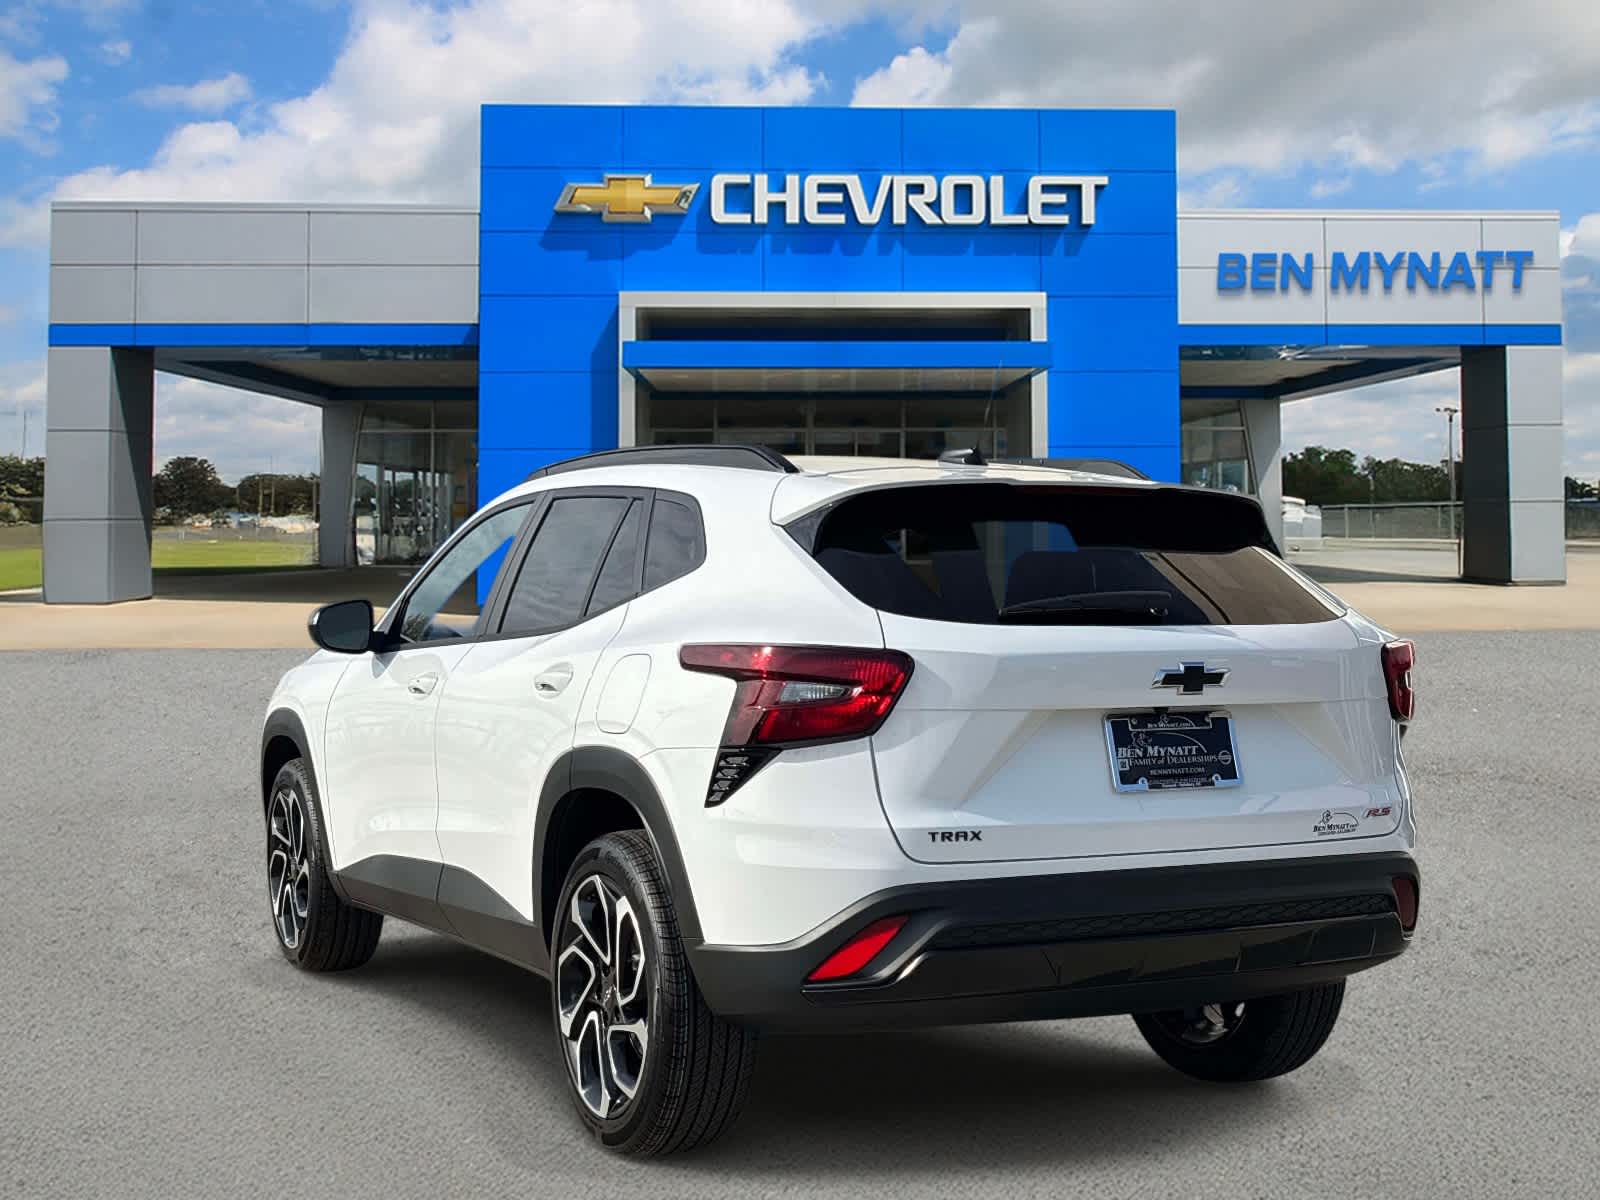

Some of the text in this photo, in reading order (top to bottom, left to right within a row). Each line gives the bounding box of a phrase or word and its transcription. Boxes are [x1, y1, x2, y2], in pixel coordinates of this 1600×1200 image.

[710, 173, 1109, 226] CHEVROLET
[1216, 250, 1534, 291] BEN MYNATT
[1117, 745, 1199, 758] BEN MYNATT
[1129, 758, 1156, 768] FAMILY
[1166, 754, 1218, 765] DEALERSHIPS
[1366, 806, 1392, 818] RS
[927, 830, 982, 843] TRAX
